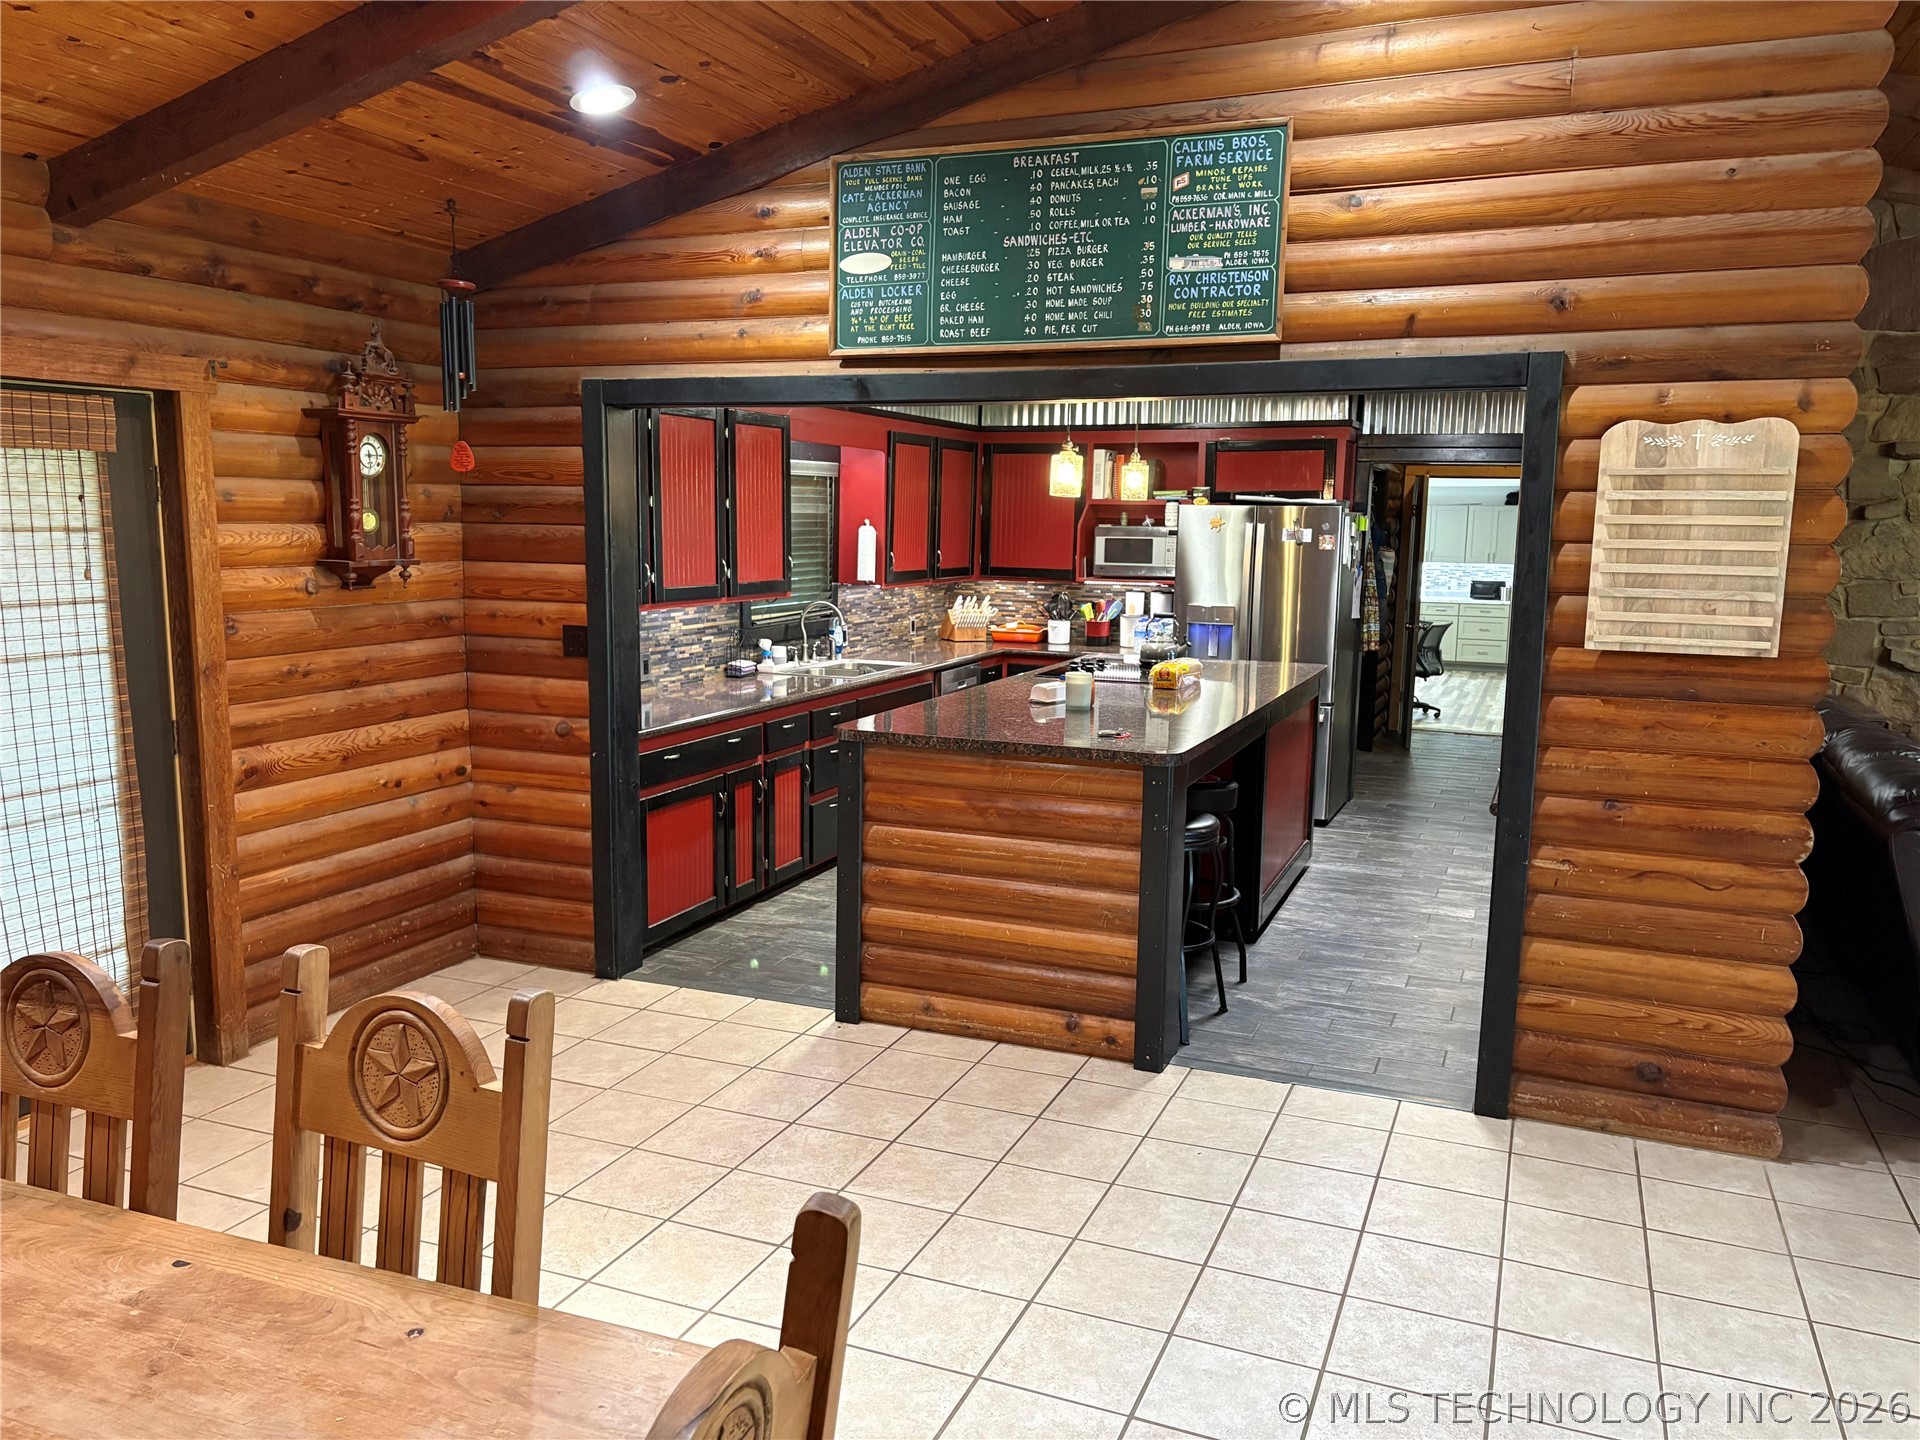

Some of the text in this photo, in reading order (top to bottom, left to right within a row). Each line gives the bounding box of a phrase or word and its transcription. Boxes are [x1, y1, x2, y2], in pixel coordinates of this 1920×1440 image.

[1174, 135, 1268, 154] CALKINS BROS.
[1014, 152, 1079, 168] BREAKFAST
[1177, 148, 1273, 167] FARM SERVICE
[843, 163, 926, 178] ALDEN STATE BANK
[1144, 161, 1157, 171] .35
[1196, 165, 1268, 176] MINOR REPAIRS
[944, 170, 1042, 184] ONE EGG .10
[1051, 175, 1157, 191] PANCAKES, EACH .10
[944, 188, 971, 198] BACON
[1196, 183, 1227, 192] BRAKE
[842, 193, 865, 203] CATE
[875, 189, 922, 201] ACKERMAN
[1050, 194, 1081, 204] DONUTS
[867, 201, 909, 212] AGENCY
[943, 200, 980, 210] SAUSAGE
[1050, 202, 1156, 217] ROLLS .10
[1249, 203, 1271, 215] INC.
[874, 213, 903, 221] INSURANCE
[943, 210, 1041, 223] HAM .50
[1102, 218, 1112, 227] OR
[1114, 217, 1130, 226] TEA
[1143, 215, 1155, 224] .10
[844, 224, 923, 239] ALDEN CO-OP
[943, 222, 1041, 236] TOAST .10
[1207, 232, 1233, 240] QUALITY
[844, 236, 924, 252] ELEVATOR CO.
[1048, 242, 1154, 256] PIZZA BURGER .35
[1203, 240, 1230, 248] SERVICE
[942, 251, 986, 262] HAMBURGER
[1048, 255, 1154, 268] VEG. BURGER .35
[942, 261, 1040, 274] CHEESEBURGER .30
[846, 275, 887, 283] TELEPHONE
[941, 274, 1039, 287] CHEESE .20
[1047, 268, 1153, 281] STEAK .50
[1169, 270, 1269, 286] RAY CHRISTENSON
[842, 284, 922, 299] ALDEN LOCKER
[941, 287, 1038, 300] EGG .20
[1046, 282, 1153, 295] HOT SANDWICHES .75
[1174, 284, 1261, 299] CONTRACTOR
[956, 302, 985, 311] CHEESE
[1024, 300, 1037, 309] .30
[1046, 295, 1152, 307] HOME MADE SOUP .30
[1190, 301, 1220, 309] BUILDING
[870, 306, 912, 314] PROCESSING
[1045, 312, 1065, 321] HOME
[1069, 311, 1088, 320] MADE
[1094, 311, 1112, 319] CHILI
[1212, 309, 1252, 317] ESTIMATES
[895, 314, 913, 322] BEEF
[940, 316, 964, 325] BAKED
[968, 316, 984, 324] HAM
[1045, 324, 1098, 336] PIE, PER CUT
[1219, 322, 1241, 330] ALDEN,
[882, 335, 911, 343] 859-7515
[940, 329, 965, 338] ROAST
[970, 328, 990, 337] BEEF
